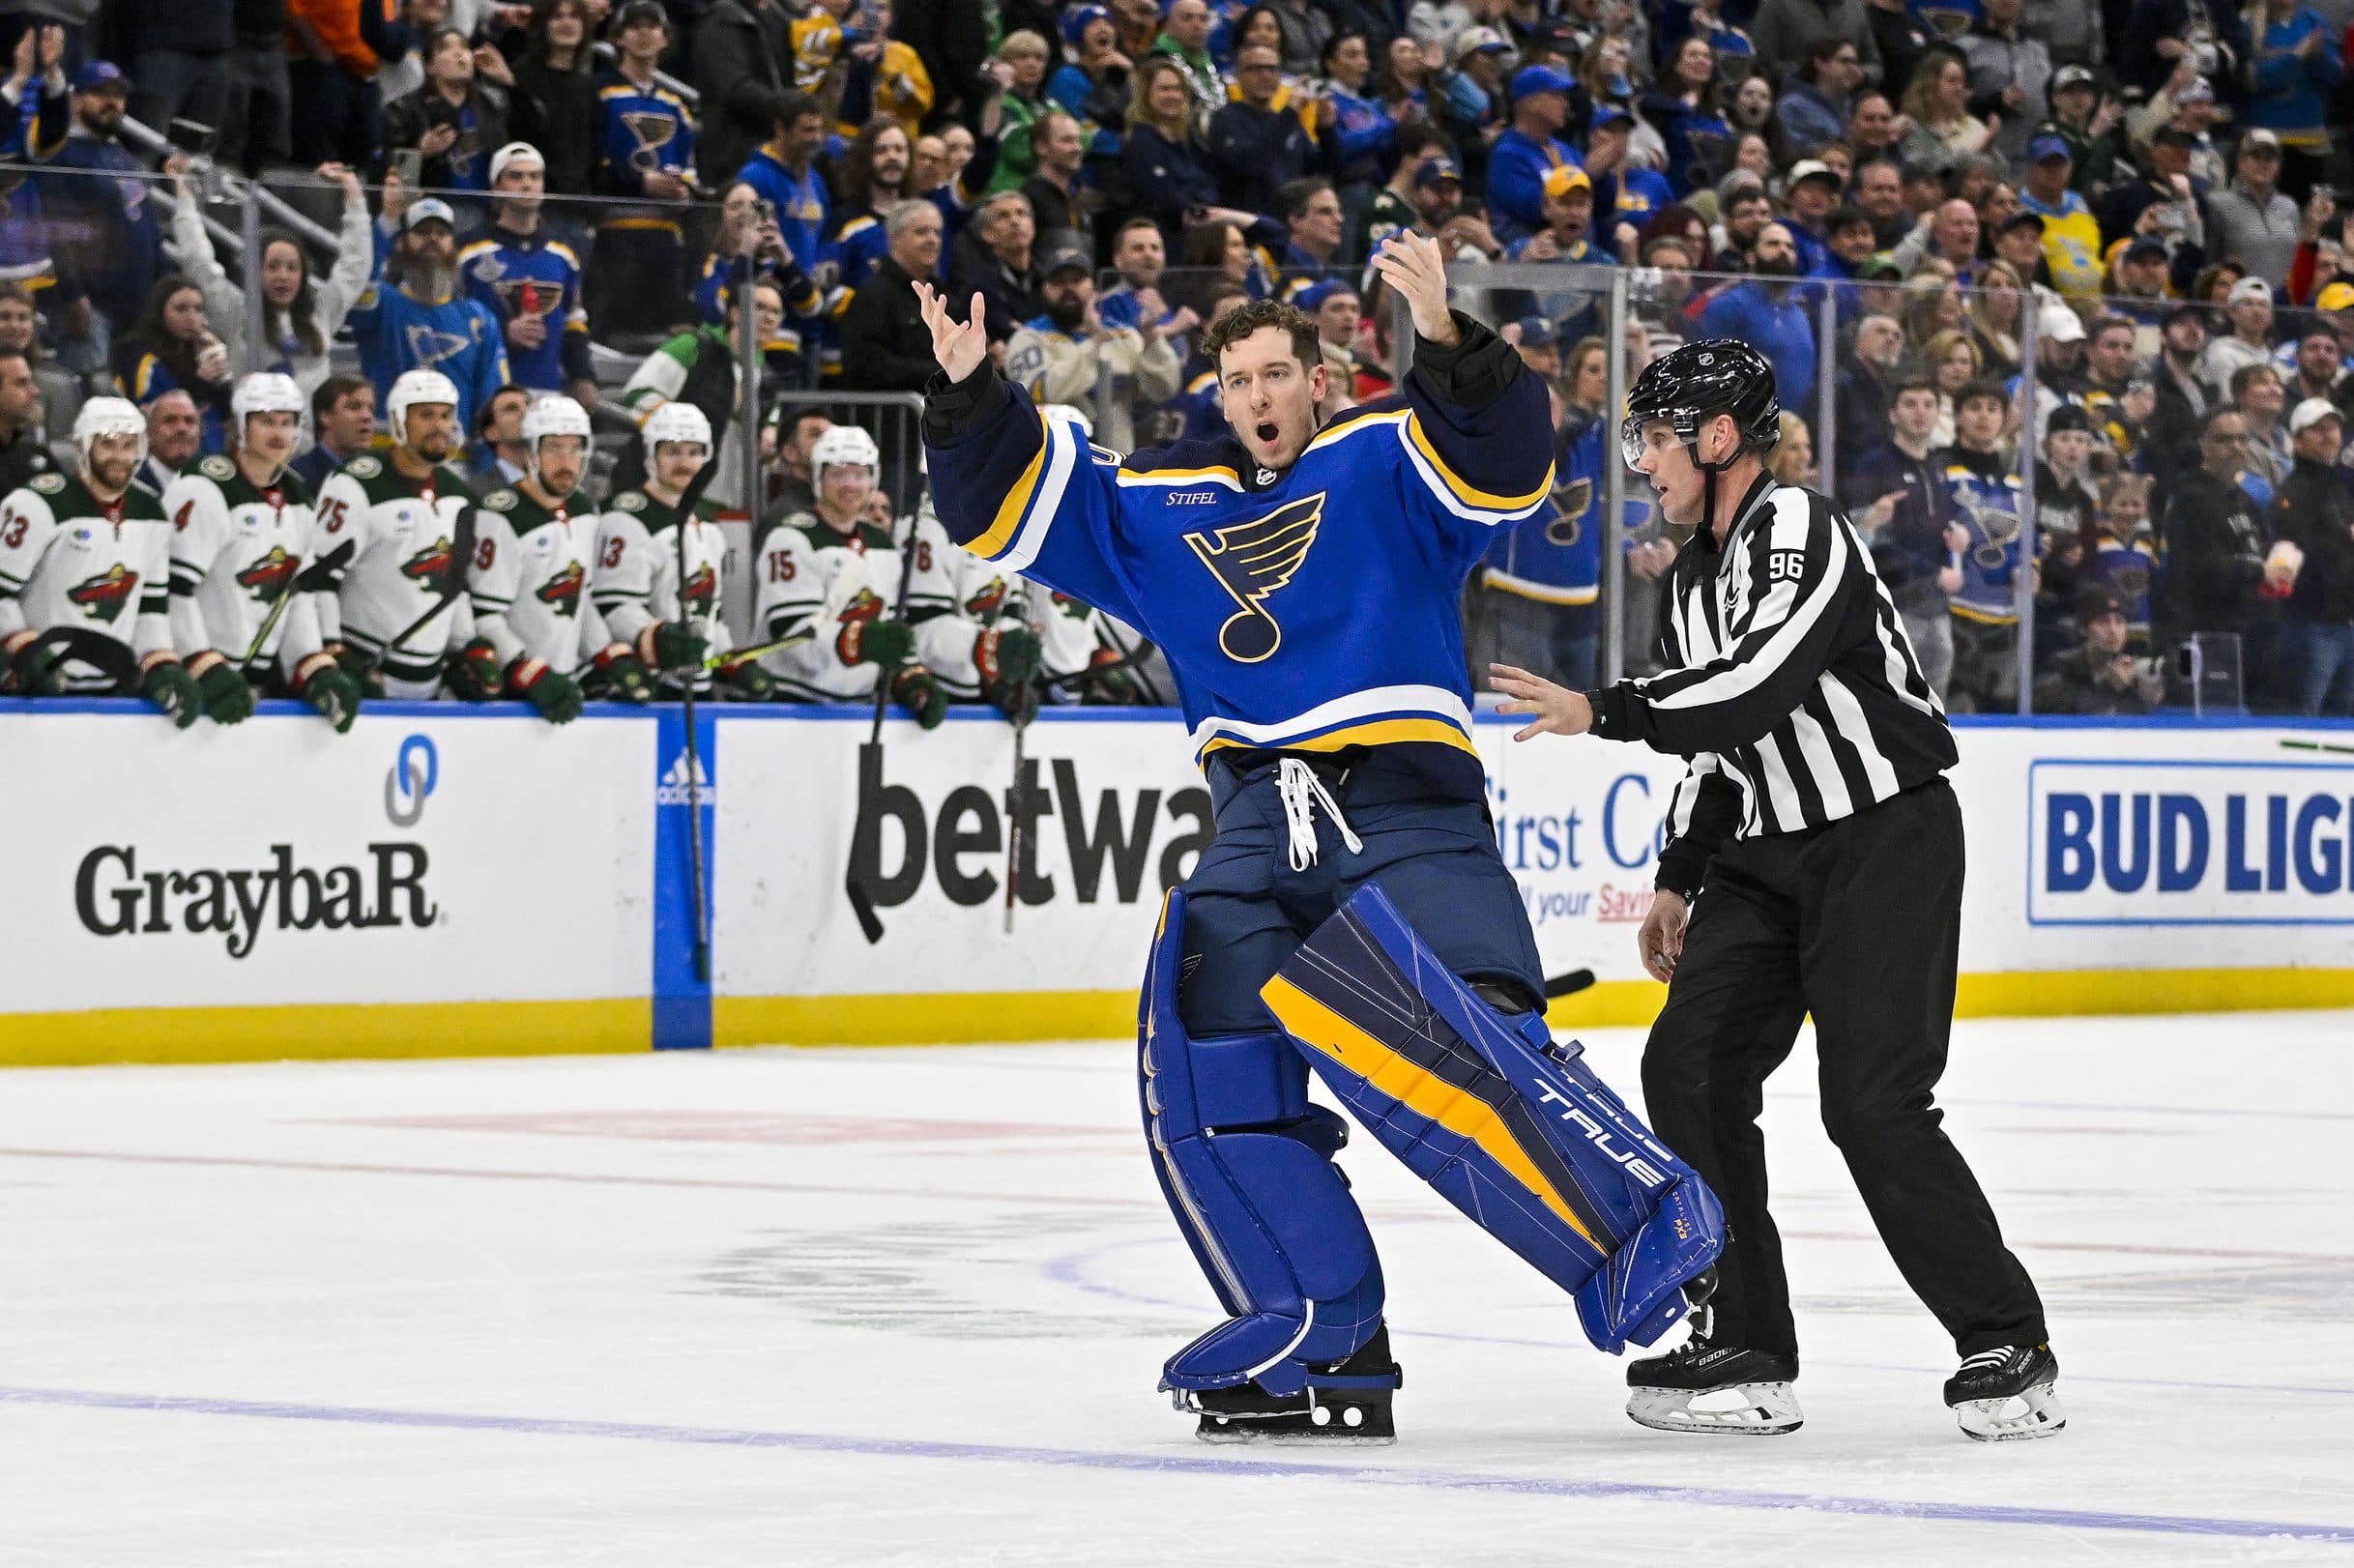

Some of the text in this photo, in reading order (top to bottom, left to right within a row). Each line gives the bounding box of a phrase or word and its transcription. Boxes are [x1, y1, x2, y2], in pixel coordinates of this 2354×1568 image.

[317, 498, 348, 533] 75
[1166, 491, 1216, 506] STIFEL
[769, 550, 796, 583] 15
[1769, 552, 1805, 579] 96
[1485, 773, 1666, 870] irst C
[2047, 793, 2354, 894] BUD LIG
[1538, 890, 1592, 925] your
[1533, 1078, 1667, 1188] TRUE
